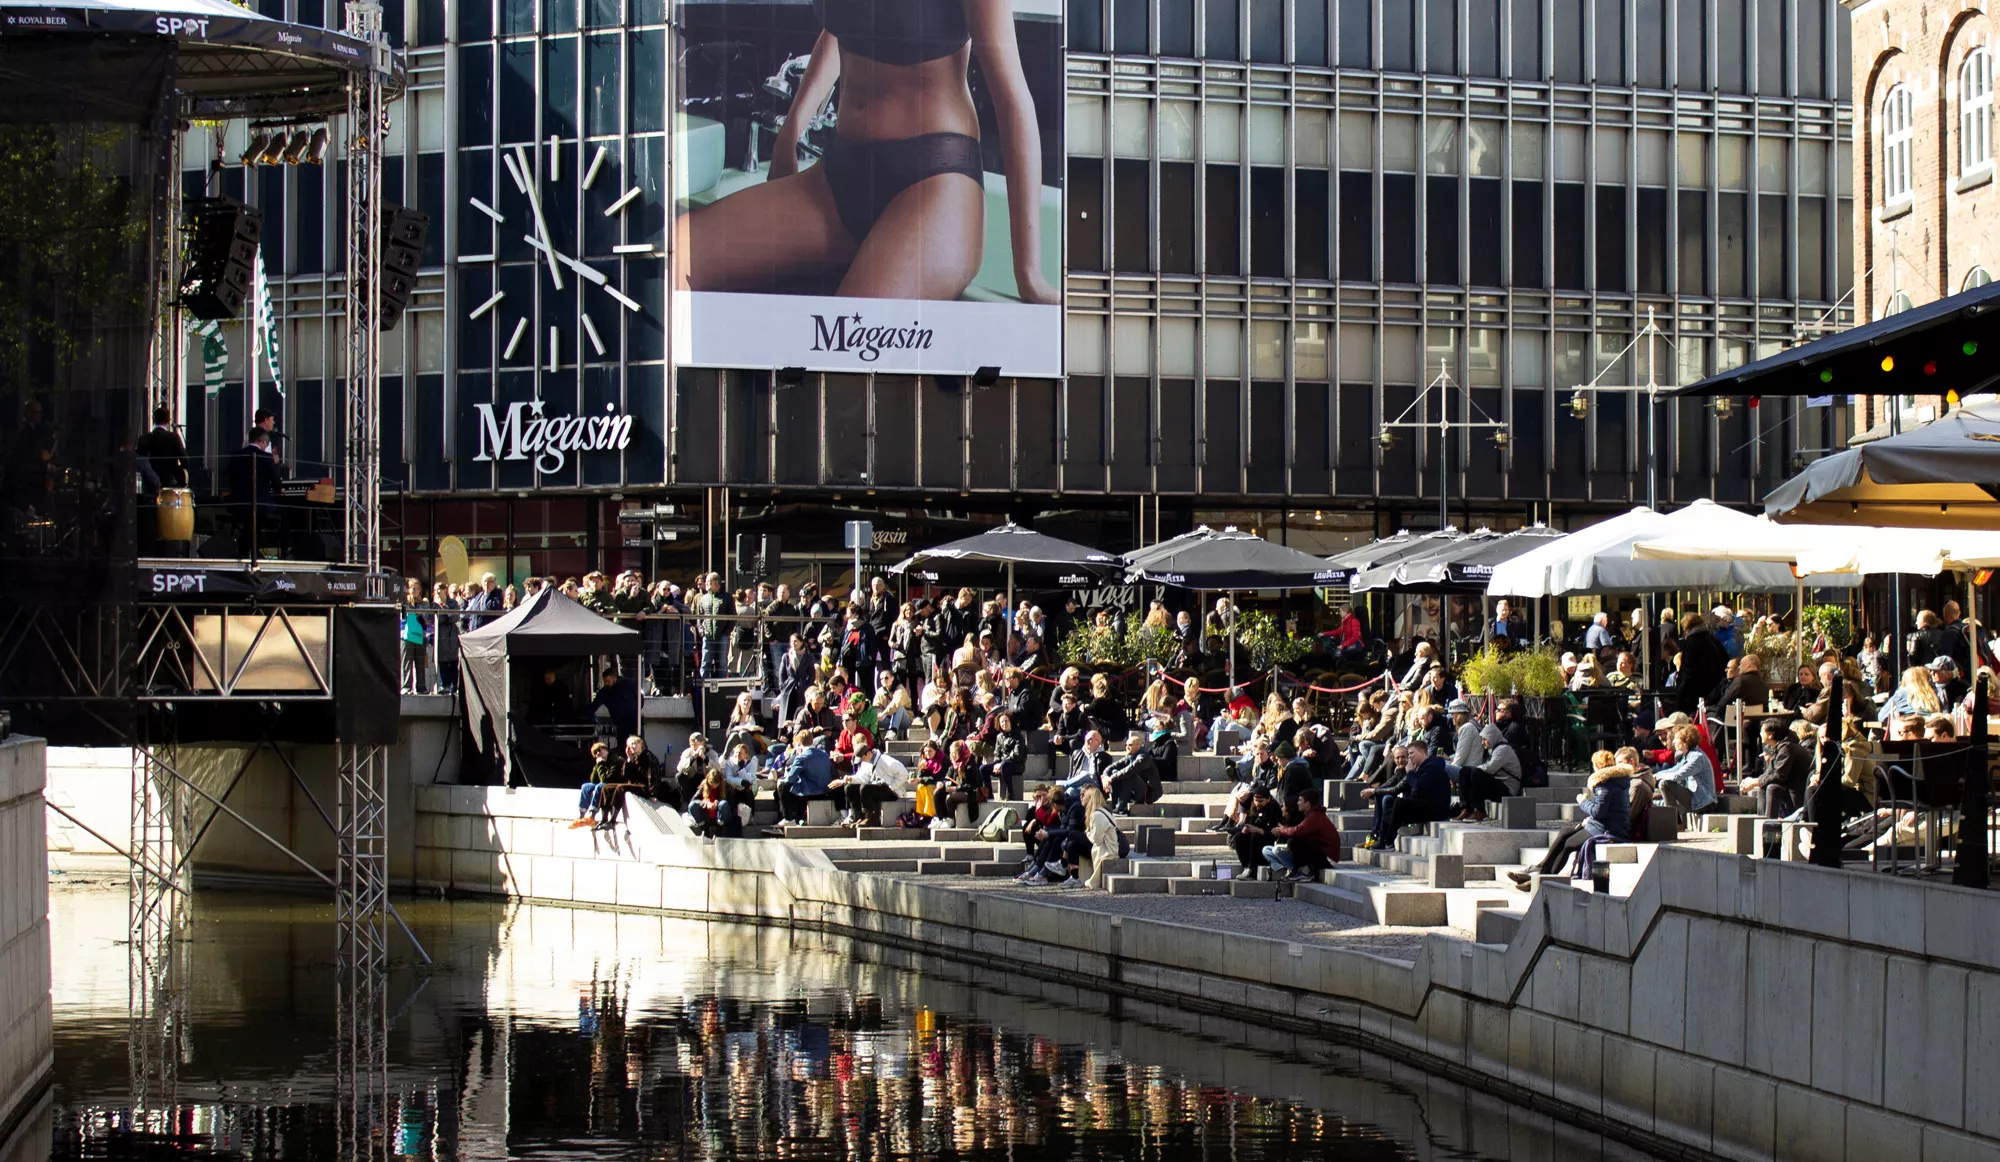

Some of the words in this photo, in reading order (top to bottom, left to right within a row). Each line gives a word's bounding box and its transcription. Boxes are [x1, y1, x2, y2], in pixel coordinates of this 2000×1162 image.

[18, 16, 45, 25] ROYAL
[46, 16, 67, 25] BEER
[156, 17, 209, 38] SPOT
[809, 312, 933, 361] Magasin
[472, 397, 632, 474] Magasin
[871, 527, 907, 551] gasin
[153, 574, 207, 592] SPOT
[1313, 570, 1346, 580] LAVAZZA
